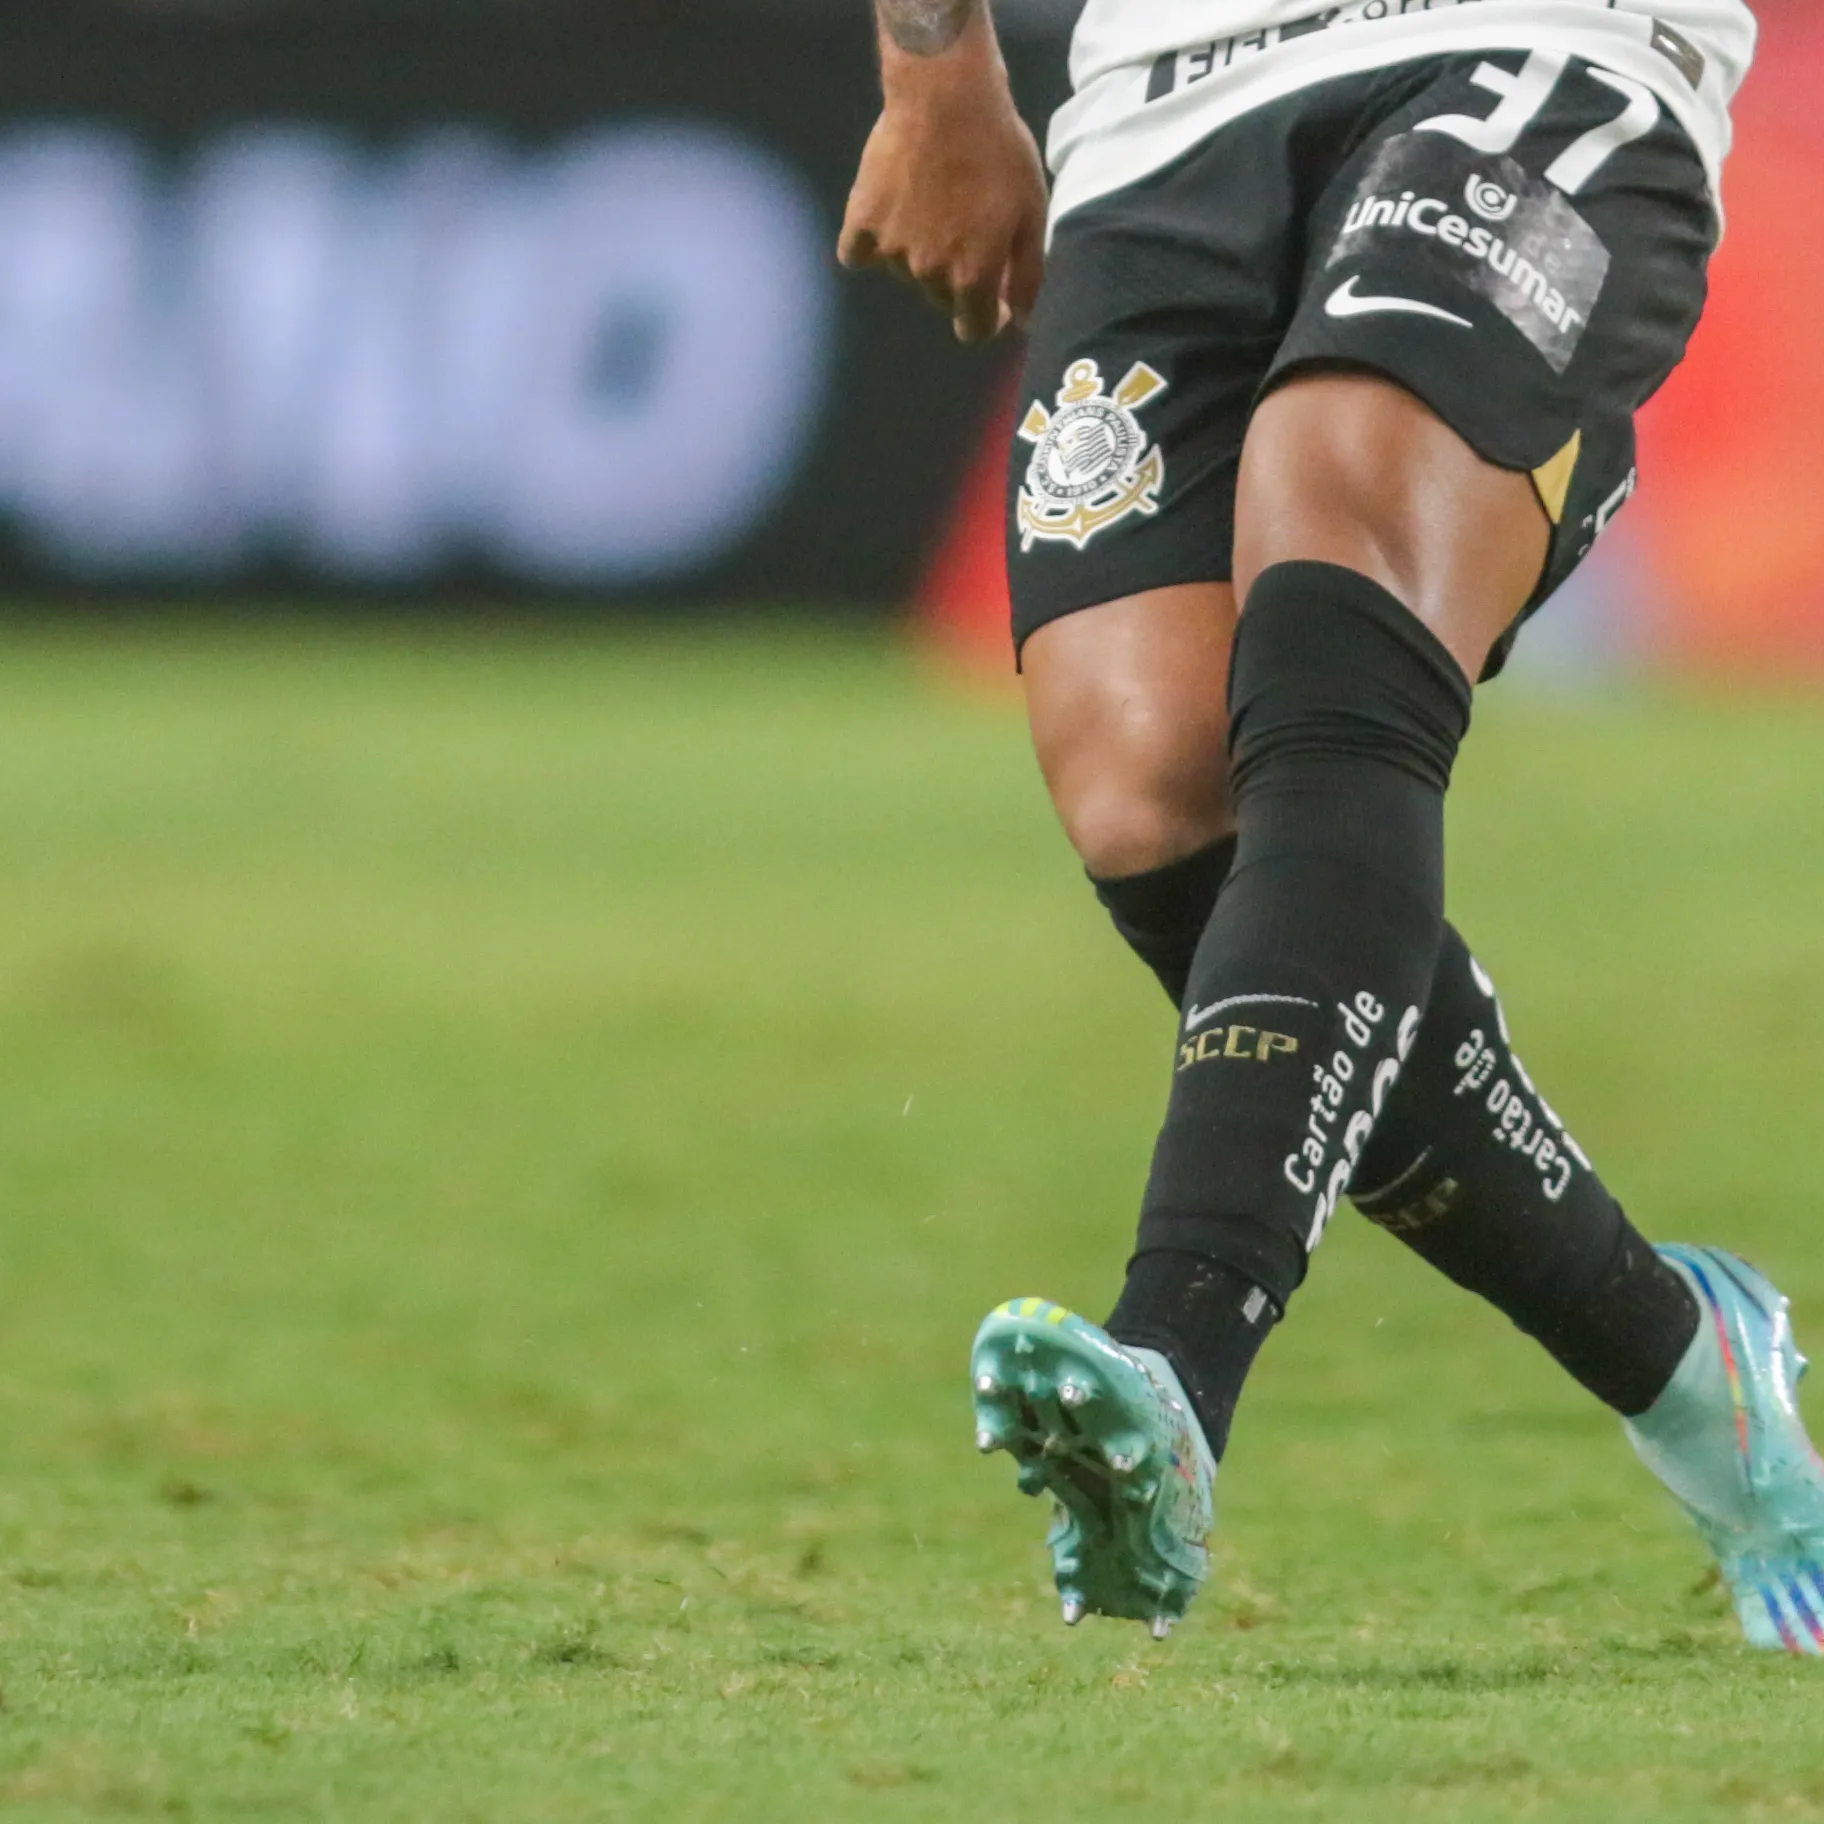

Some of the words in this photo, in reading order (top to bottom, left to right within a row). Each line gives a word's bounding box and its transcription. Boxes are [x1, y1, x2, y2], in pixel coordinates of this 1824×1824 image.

[1412, 48, 1660, 197] 37
[1177, 1024, 1300, 1072] SCCP
[1284, 1049, 1355, 1195] Cartão
[1336, 990, 1385, 1049] de
